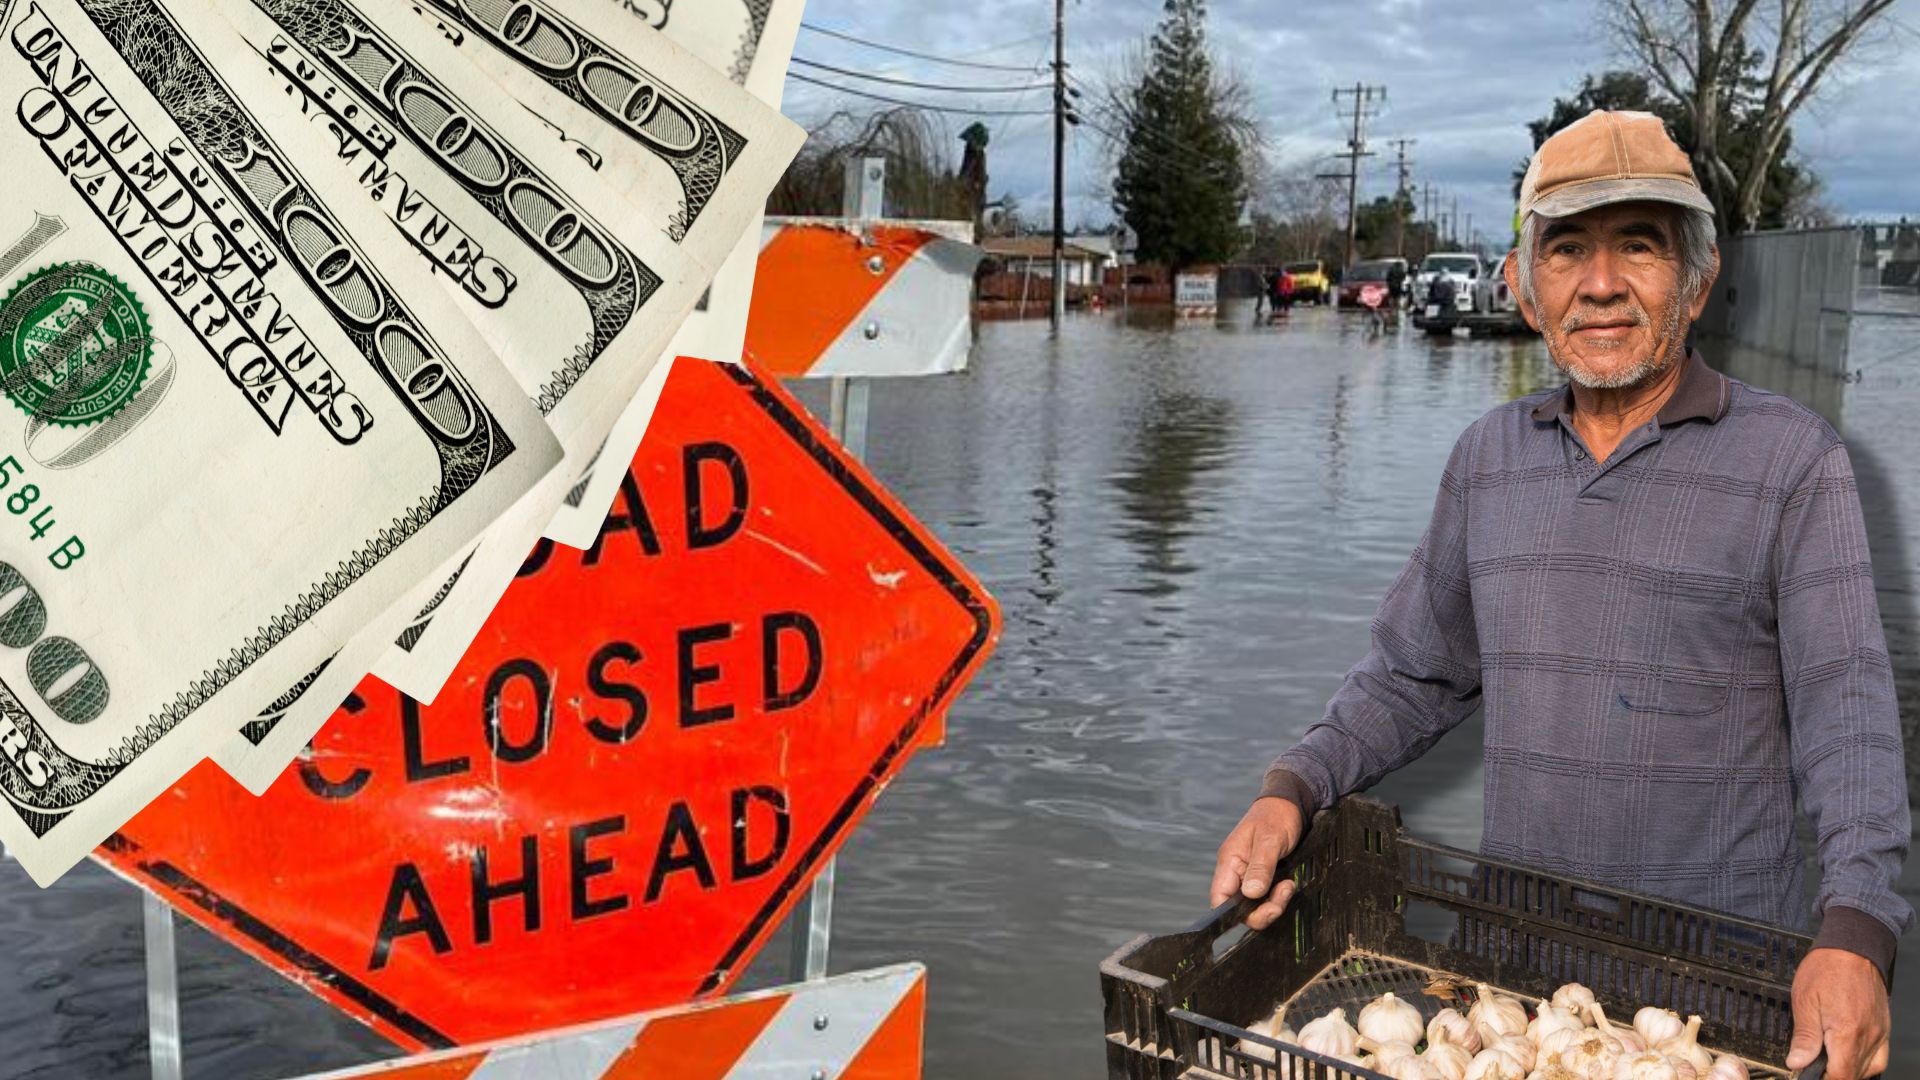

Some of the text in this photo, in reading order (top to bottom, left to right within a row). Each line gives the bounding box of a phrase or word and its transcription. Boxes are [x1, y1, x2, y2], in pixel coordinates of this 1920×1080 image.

[266, 34, 397, 160] THE
[315, 23, 620, 293] 100
[11, 0, 375, 447] UNITED STATES
[17, 86, 297, 437] OF AMERICA
[163, 136, 278, 280] THE
[214, 136, 479, 448] 100
[67, 370, 134, 416] TREASURY
[0, 455, 86, 571] 584 B
[515, 441, 750, 577] AD
[298, 610, 823, 800] CLOSED
[367, 785, 792, 973] AHEAD
